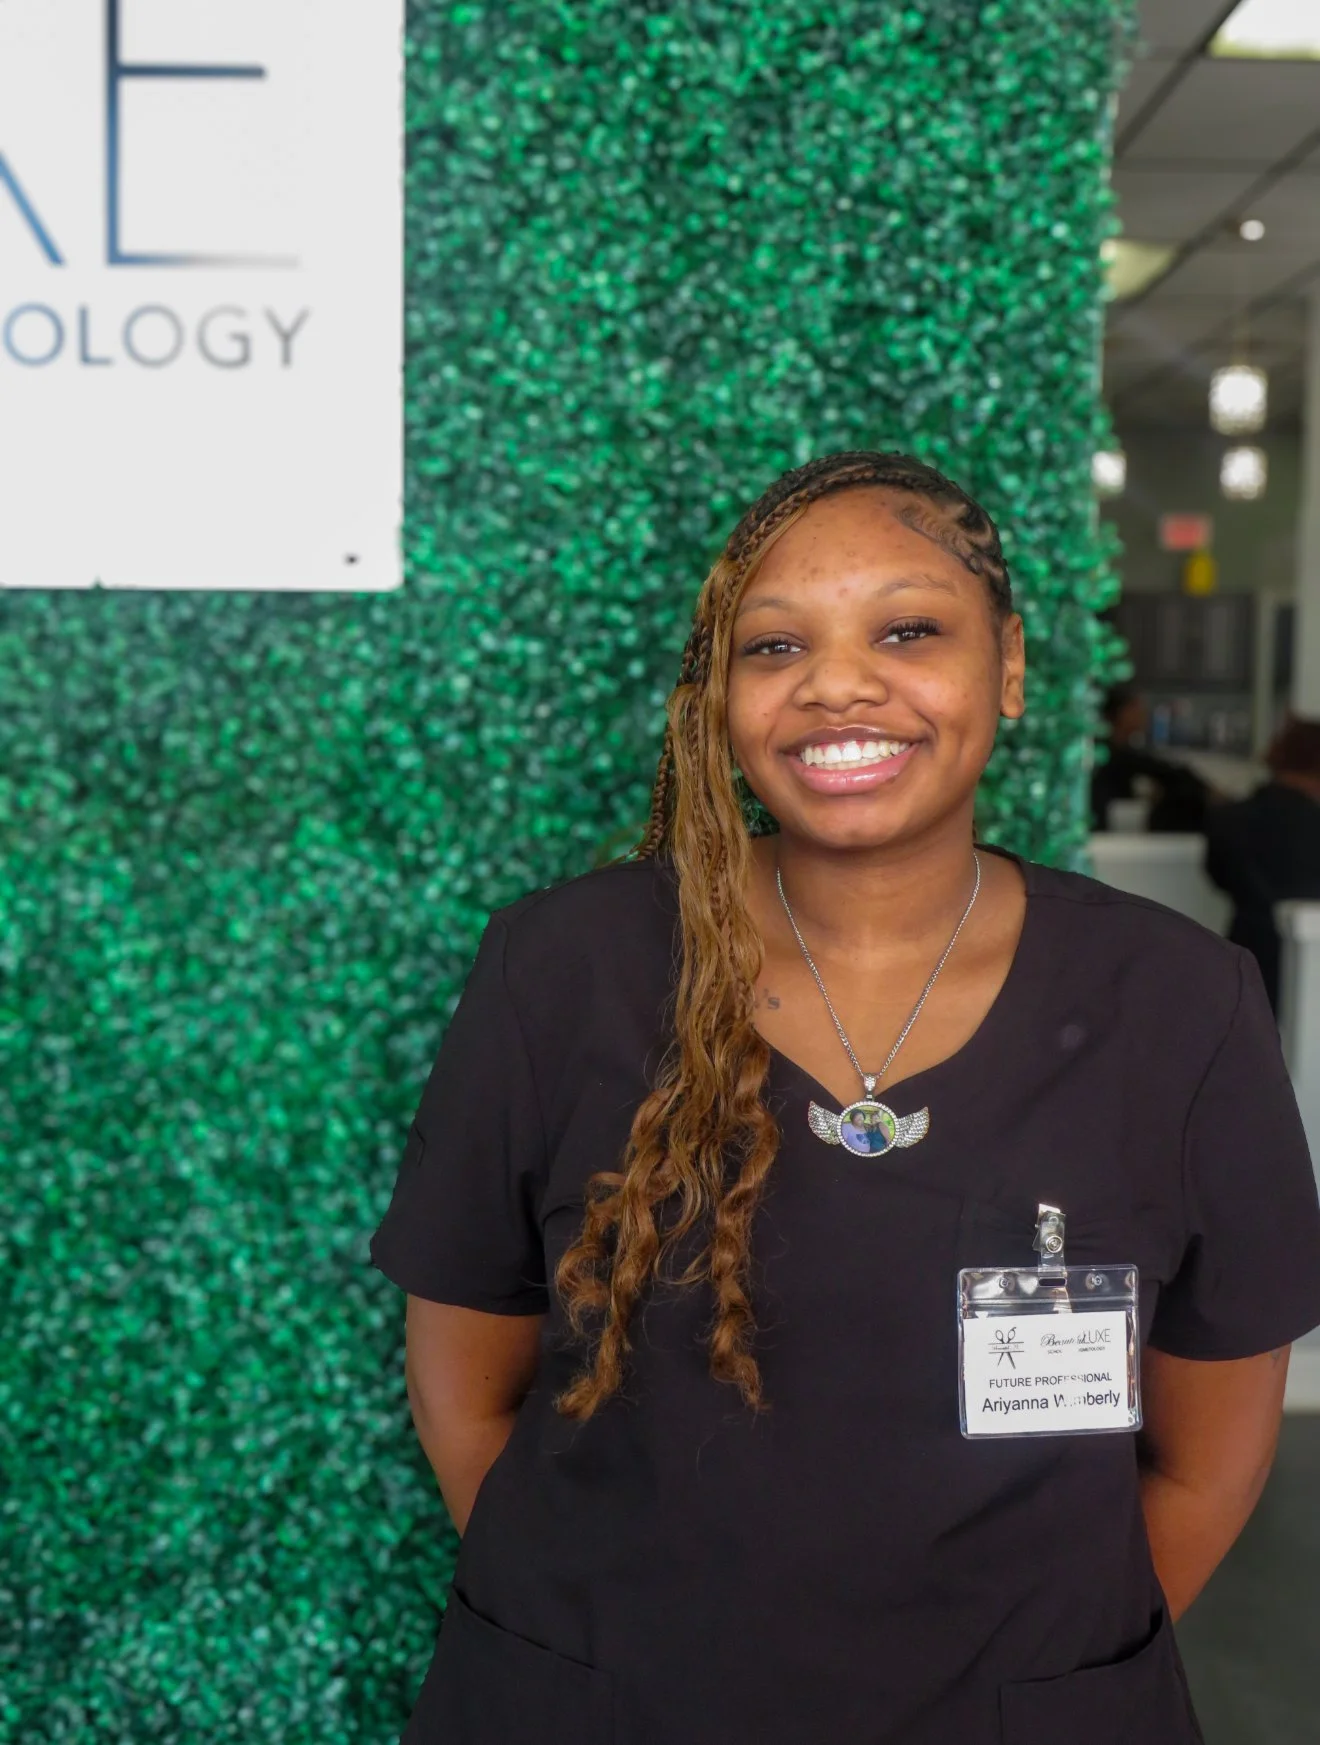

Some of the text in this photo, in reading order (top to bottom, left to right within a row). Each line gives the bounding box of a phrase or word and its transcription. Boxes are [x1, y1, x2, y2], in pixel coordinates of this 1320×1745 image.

[2, 302, 312, 369] OLOGY
[989, 1372, 1112, 1388] FUTURE PROFESSIONAL
[982, 1390, 1121, 1415] Ariyanna Wmberly
